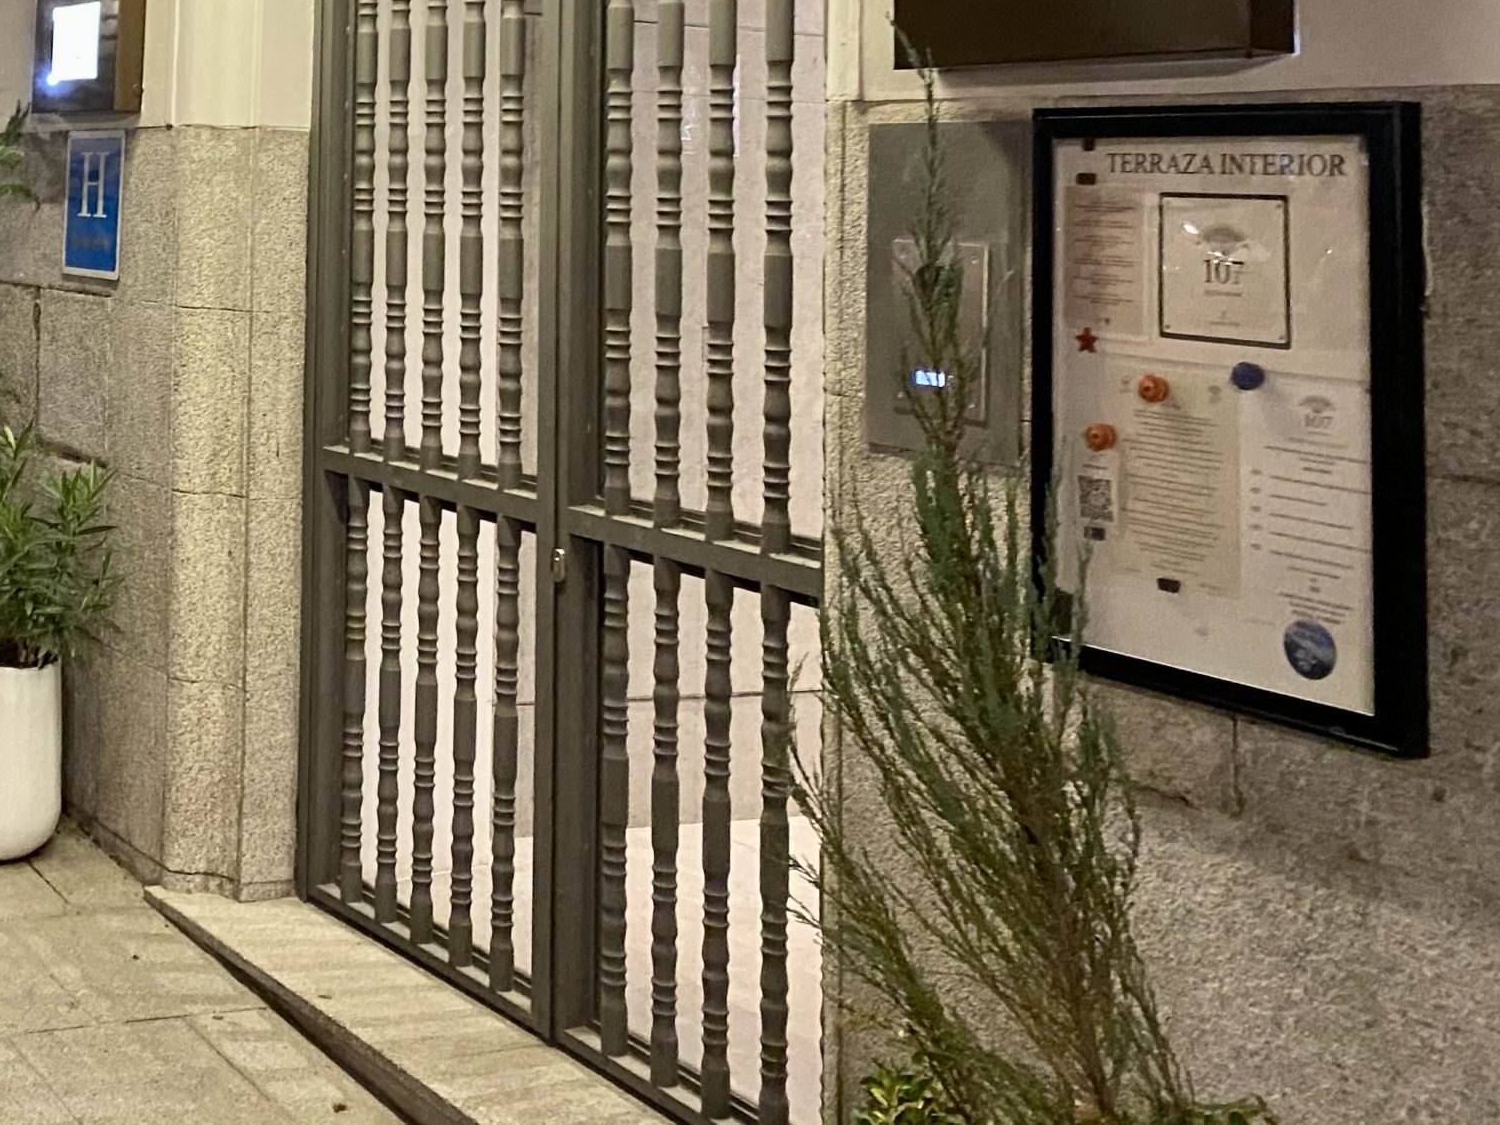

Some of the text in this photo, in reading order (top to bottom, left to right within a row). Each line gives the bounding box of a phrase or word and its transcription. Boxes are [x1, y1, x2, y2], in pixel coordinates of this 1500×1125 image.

[77, 151, 110, 218] H
[1106, 153, 1346, 177] TERRAZA INTERIOR
